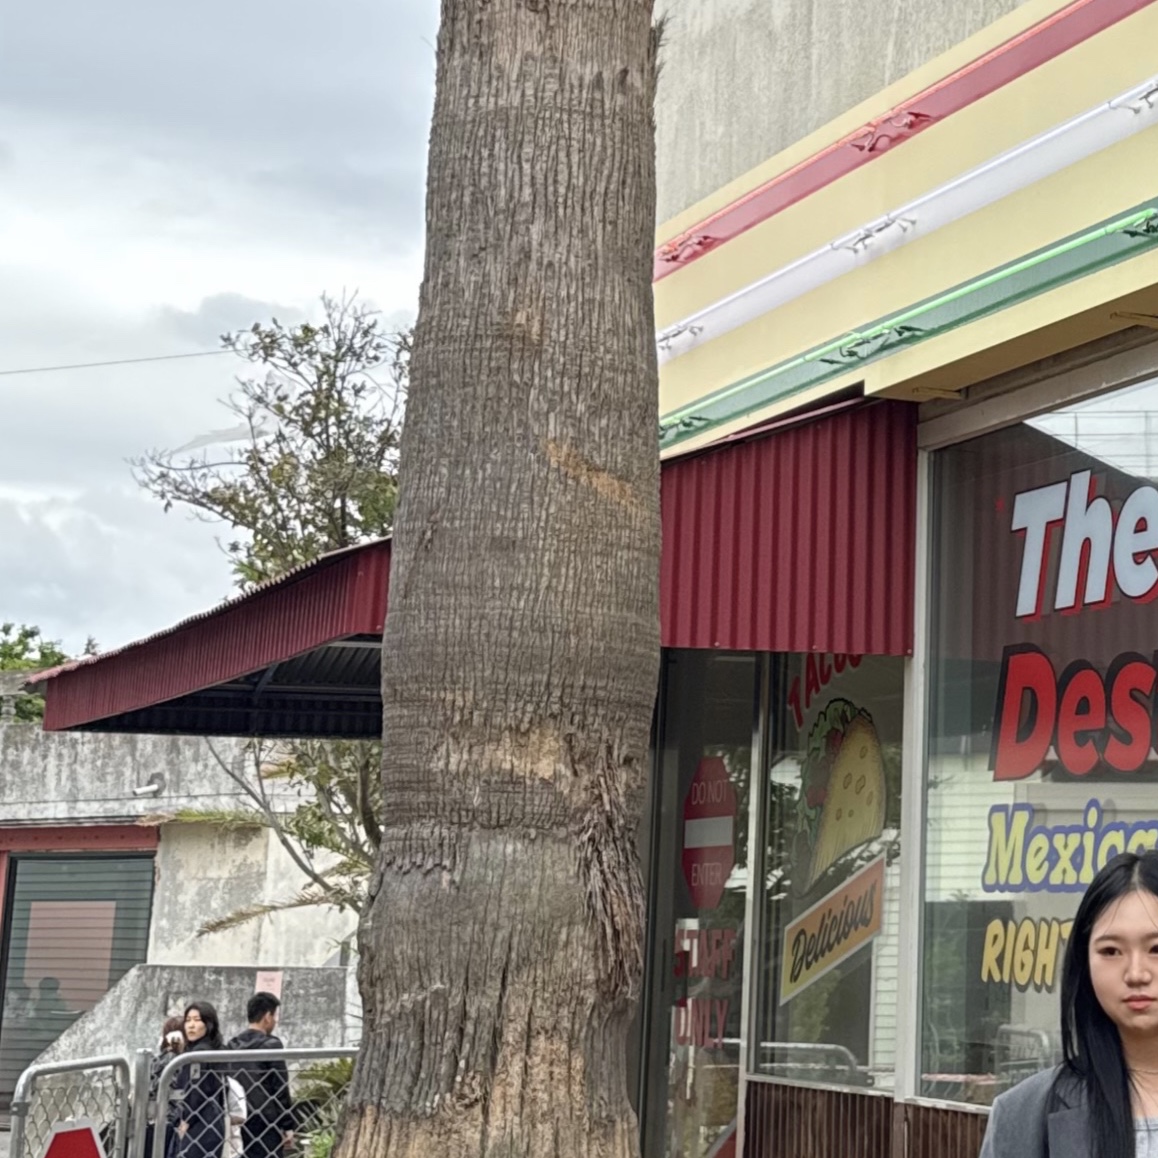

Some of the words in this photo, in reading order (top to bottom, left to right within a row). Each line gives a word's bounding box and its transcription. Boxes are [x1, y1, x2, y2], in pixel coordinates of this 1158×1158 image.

[691, 782, 706, 805] DO
[708, 779, 728, 803] NOT
[691, 862, 722, 887] ENTER
[673, 928, 738, 978] STAFF
[790, 876, 878, 986] Delicious
[981, 916, 1075, 994] RIGH
[674, 997, 729, 1049] ONLY
